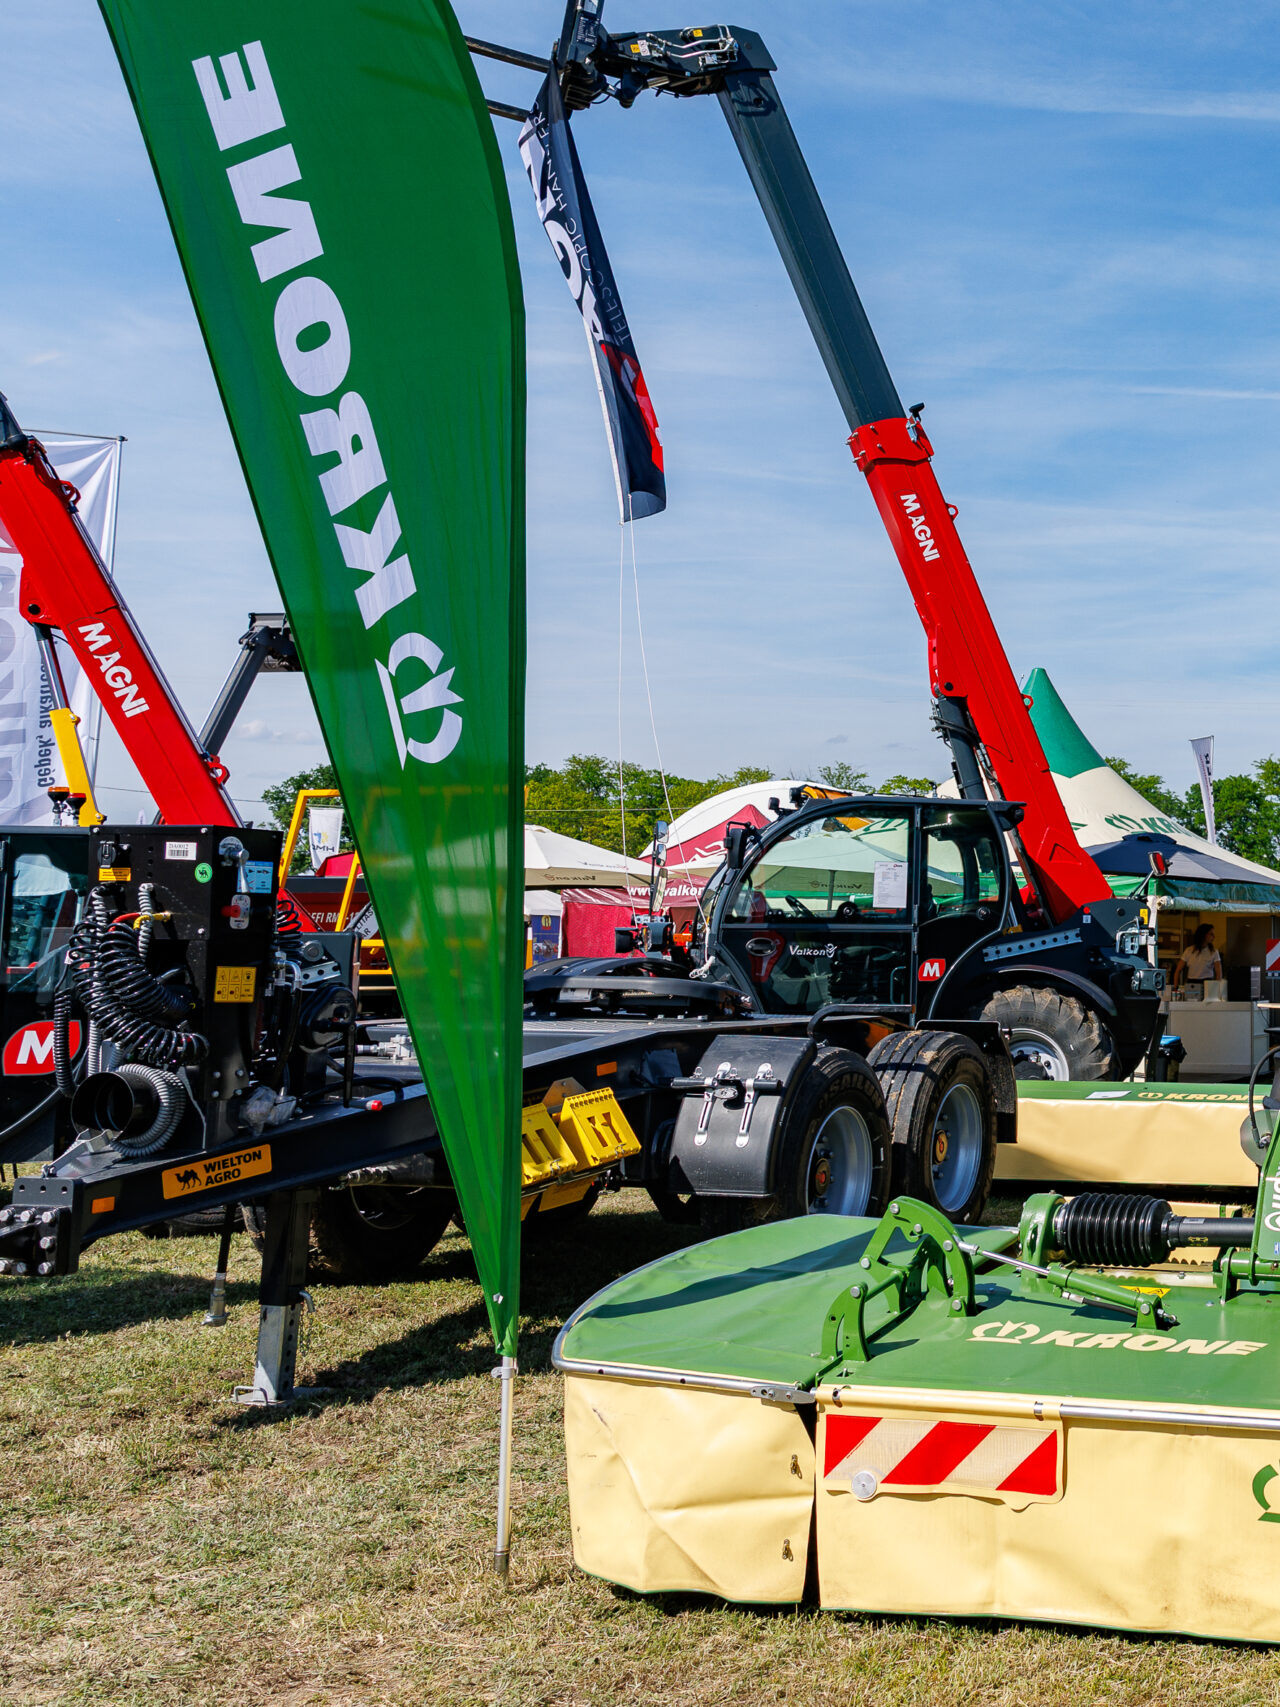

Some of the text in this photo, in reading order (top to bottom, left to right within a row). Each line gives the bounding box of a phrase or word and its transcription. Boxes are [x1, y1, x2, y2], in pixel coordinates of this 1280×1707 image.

[900, 493, 940, 563] MAGNI
[77, 622, 151, 718] MAGNI
[789, 945, 826, 956] Valkon
[922, 962, 940, 977] M
[16, 1030, 56, 1064] M
[203, 1150, 262, 1174] WIELTON
[205, 1168, 241, 1186] AGRO
[1030, 1330, 1269, 1357] KRONE
